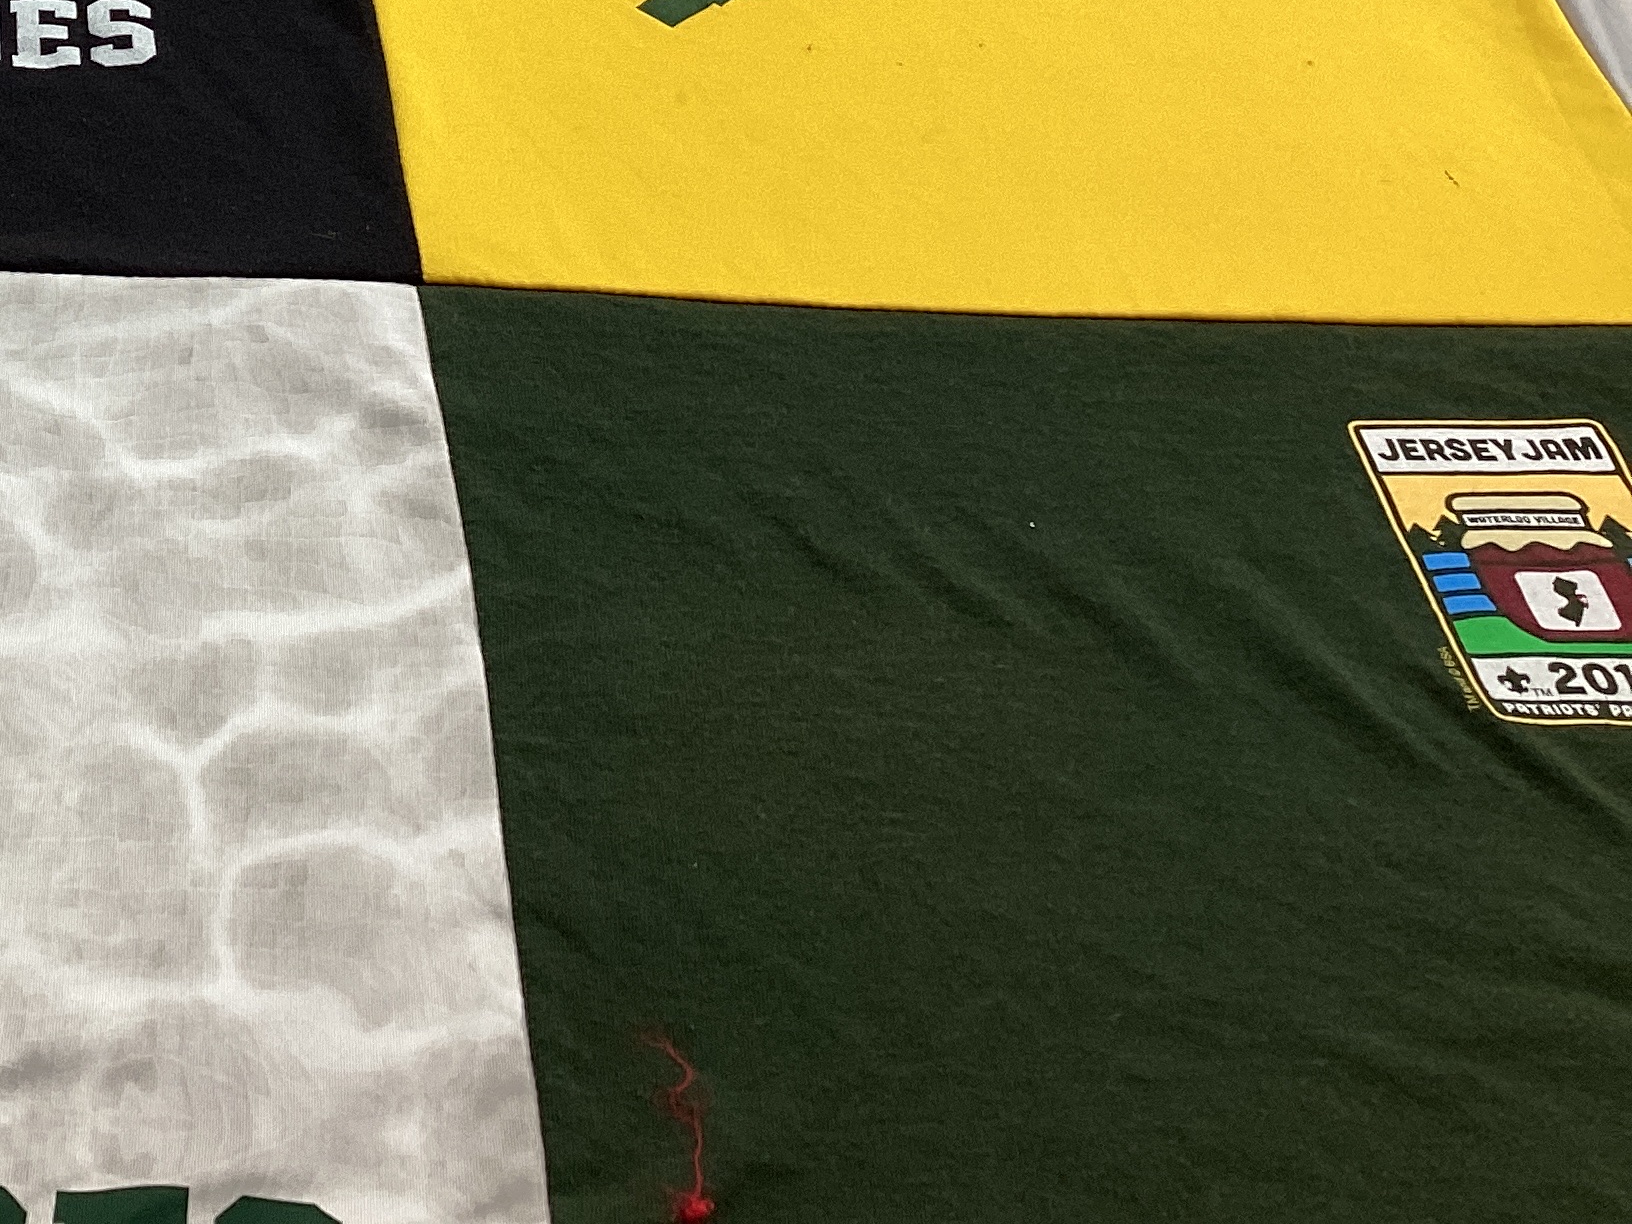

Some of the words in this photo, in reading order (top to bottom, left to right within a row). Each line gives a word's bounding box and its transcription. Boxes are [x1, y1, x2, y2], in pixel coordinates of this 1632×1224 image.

[1377, 438, 1515, 462] JERSEY
[1520, 436, 1604, 462] JAM
[1533, 514, 1581, 526] VILLAGE
[1532, 687, 1554, 697] TM
[1502, 702, 1601, 718] PATRIOTS'
